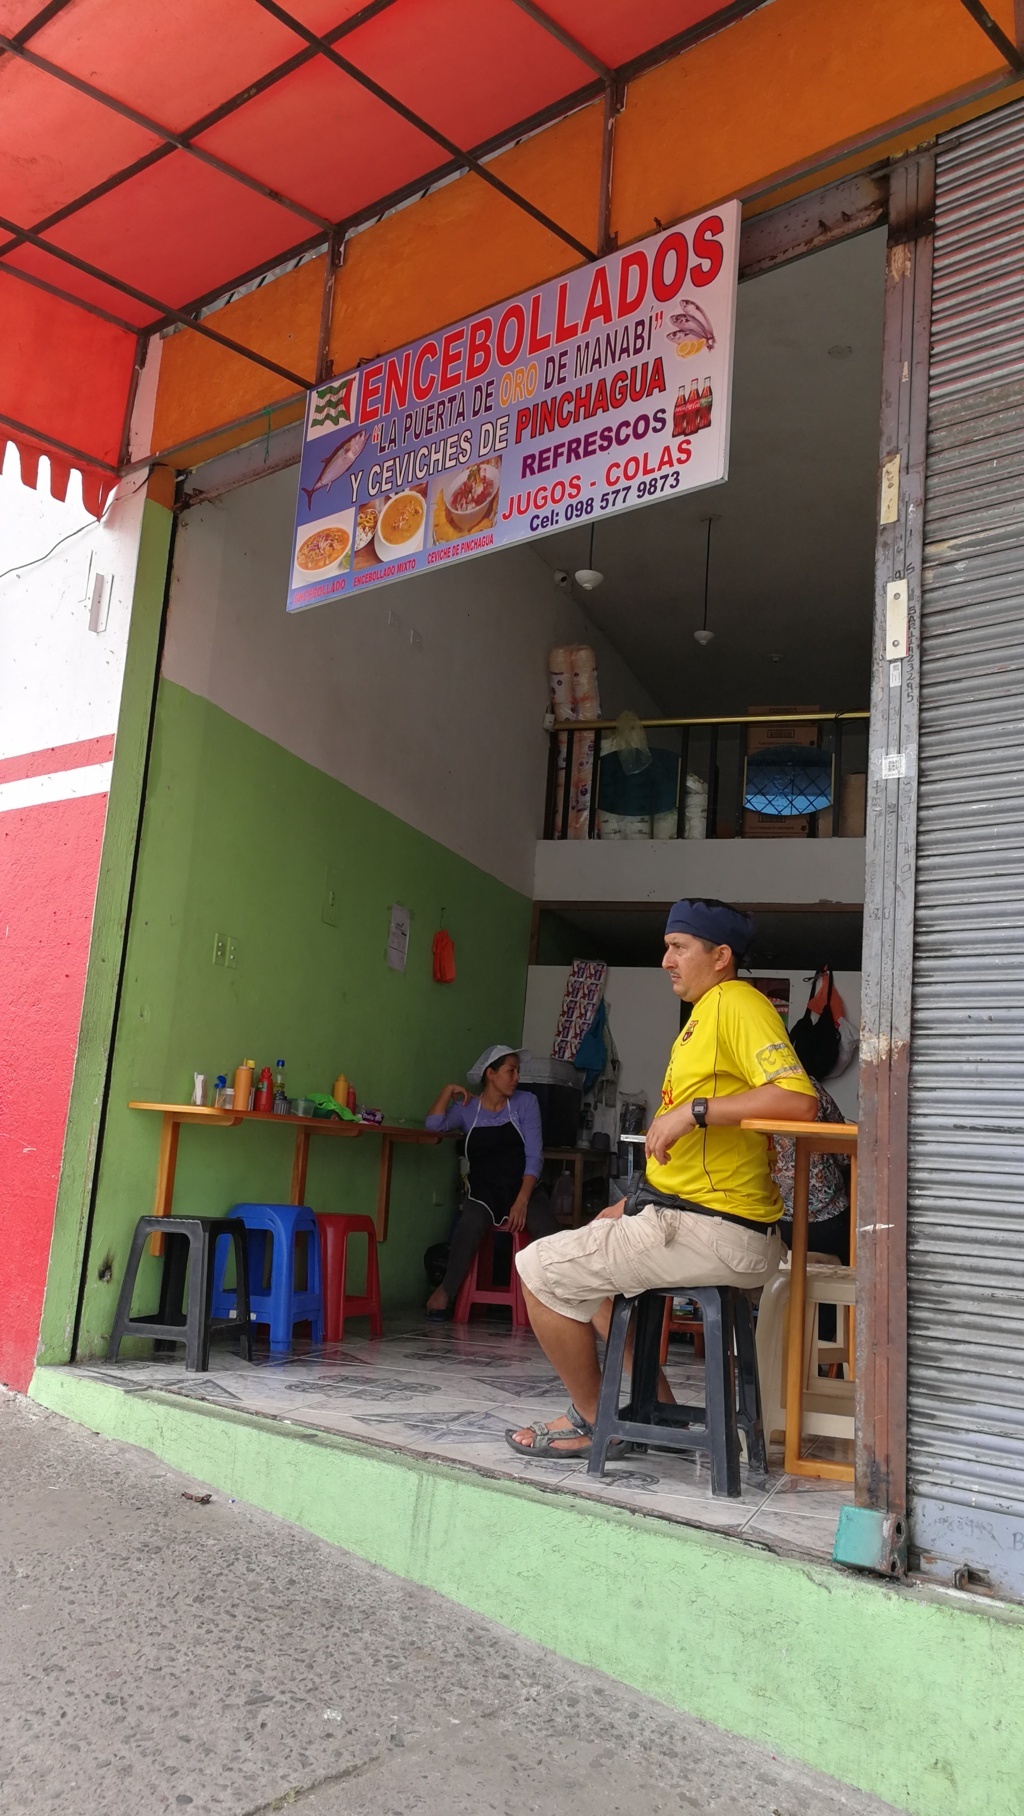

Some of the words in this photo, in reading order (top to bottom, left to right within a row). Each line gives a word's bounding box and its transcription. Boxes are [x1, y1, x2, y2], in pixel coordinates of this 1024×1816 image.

[359, 215, 724, 424] ENCEBOLLADOS
[350, 470, 364, 502] Y
[367, 429, 472, 497] CEVICHES
[479, 415, 509, 457] DE
[514, 356, 667, 444] PINCHAGUA
[402, 390, 466, 445] PUERTA
[471, 378, 496, 419] DE
[500, 361, 538, 407] ORO
[544, 349, 569, 390] DE
[501, 475, 582, 521] JUGOS
[605, 439, 692, 487] COLAS
[521, 408, 667, 480] REFRESCOS
[530, 510, 559, 532] Cel:
[564, 498, 595, 521] 098
[600, 486, 632, 510] 577
[637, 470, 680, 499] 9873
[353, 565, 395, 587] ENCEBOLLADO
[397, 558, 416, 574] MIXTO
[427, 548, 451, 564] CEVICHE
[451, 544, 460, 557] DE
[460, 534, 494, 554] PINCHAGUA
[293, 578, 346, 605] ENCEBOLLADO
